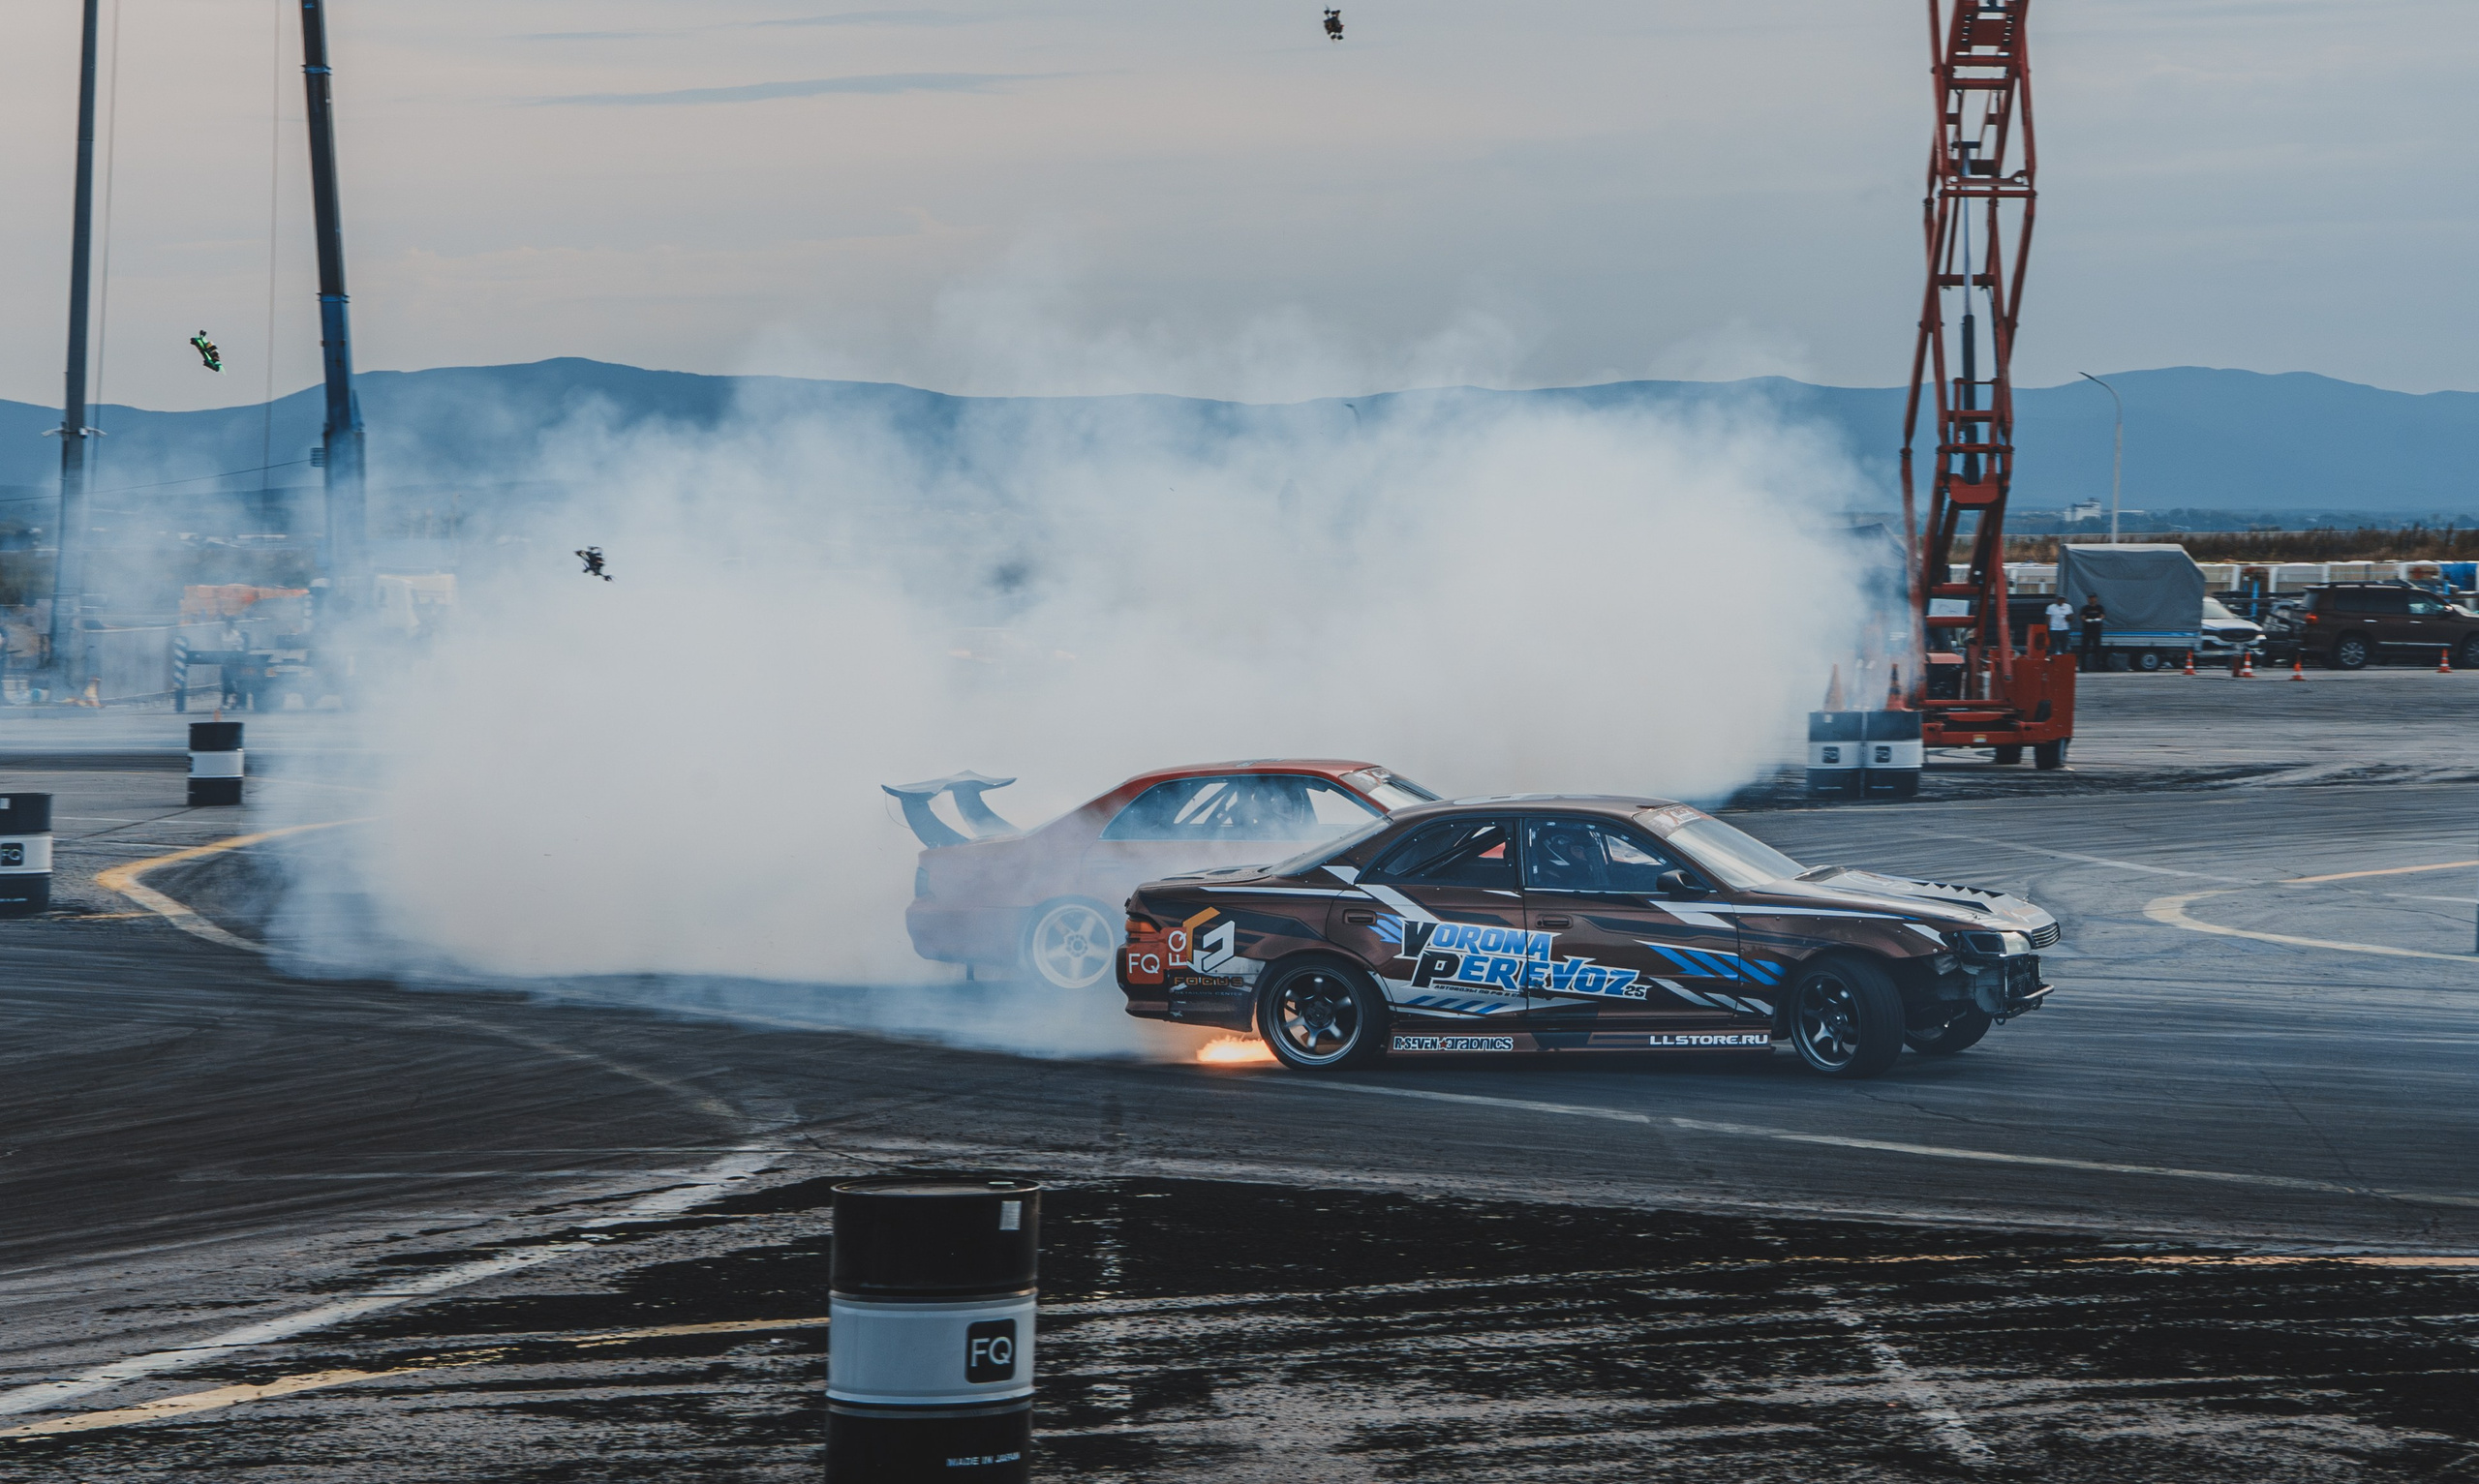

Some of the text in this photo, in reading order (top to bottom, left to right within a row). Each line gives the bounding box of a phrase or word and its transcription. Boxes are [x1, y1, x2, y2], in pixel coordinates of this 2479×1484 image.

[1168, 930, 1187, 966] FQ
[1401, 920, 1552, 961] VORONA
[1128, 953, 1161, 974] FQ
[1412, 950, 1638, 996] PEREVOZ
[1174, 977, 1244, 986] FOCUS
[1649, 1034, 1768, 1045] LLSTORE.RU
[970, 1336, 1013, 1367] FQ
